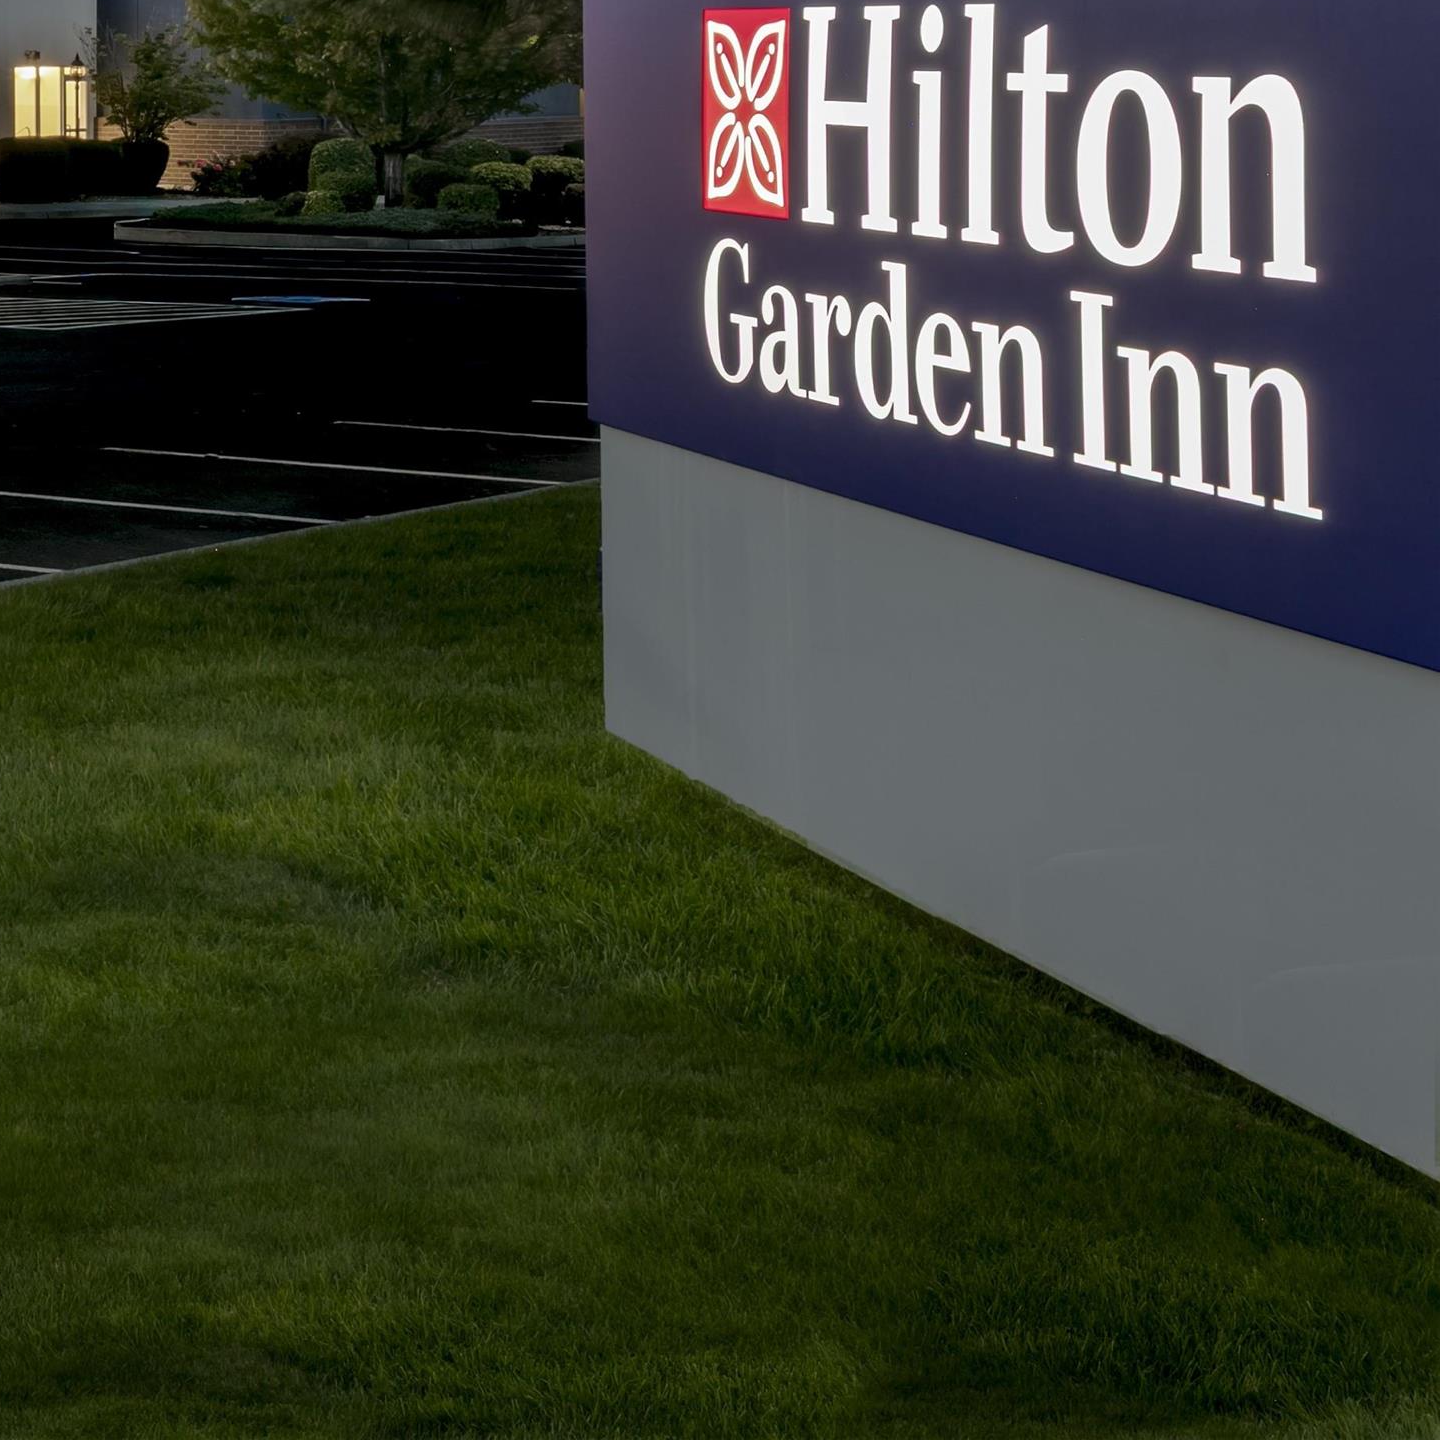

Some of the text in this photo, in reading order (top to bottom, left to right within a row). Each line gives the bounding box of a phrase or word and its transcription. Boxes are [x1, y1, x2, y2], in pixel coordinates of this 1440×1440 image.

[801, 3, 1318, 284] Hilton
[703, 237, 1324, 522] Garden Inn
